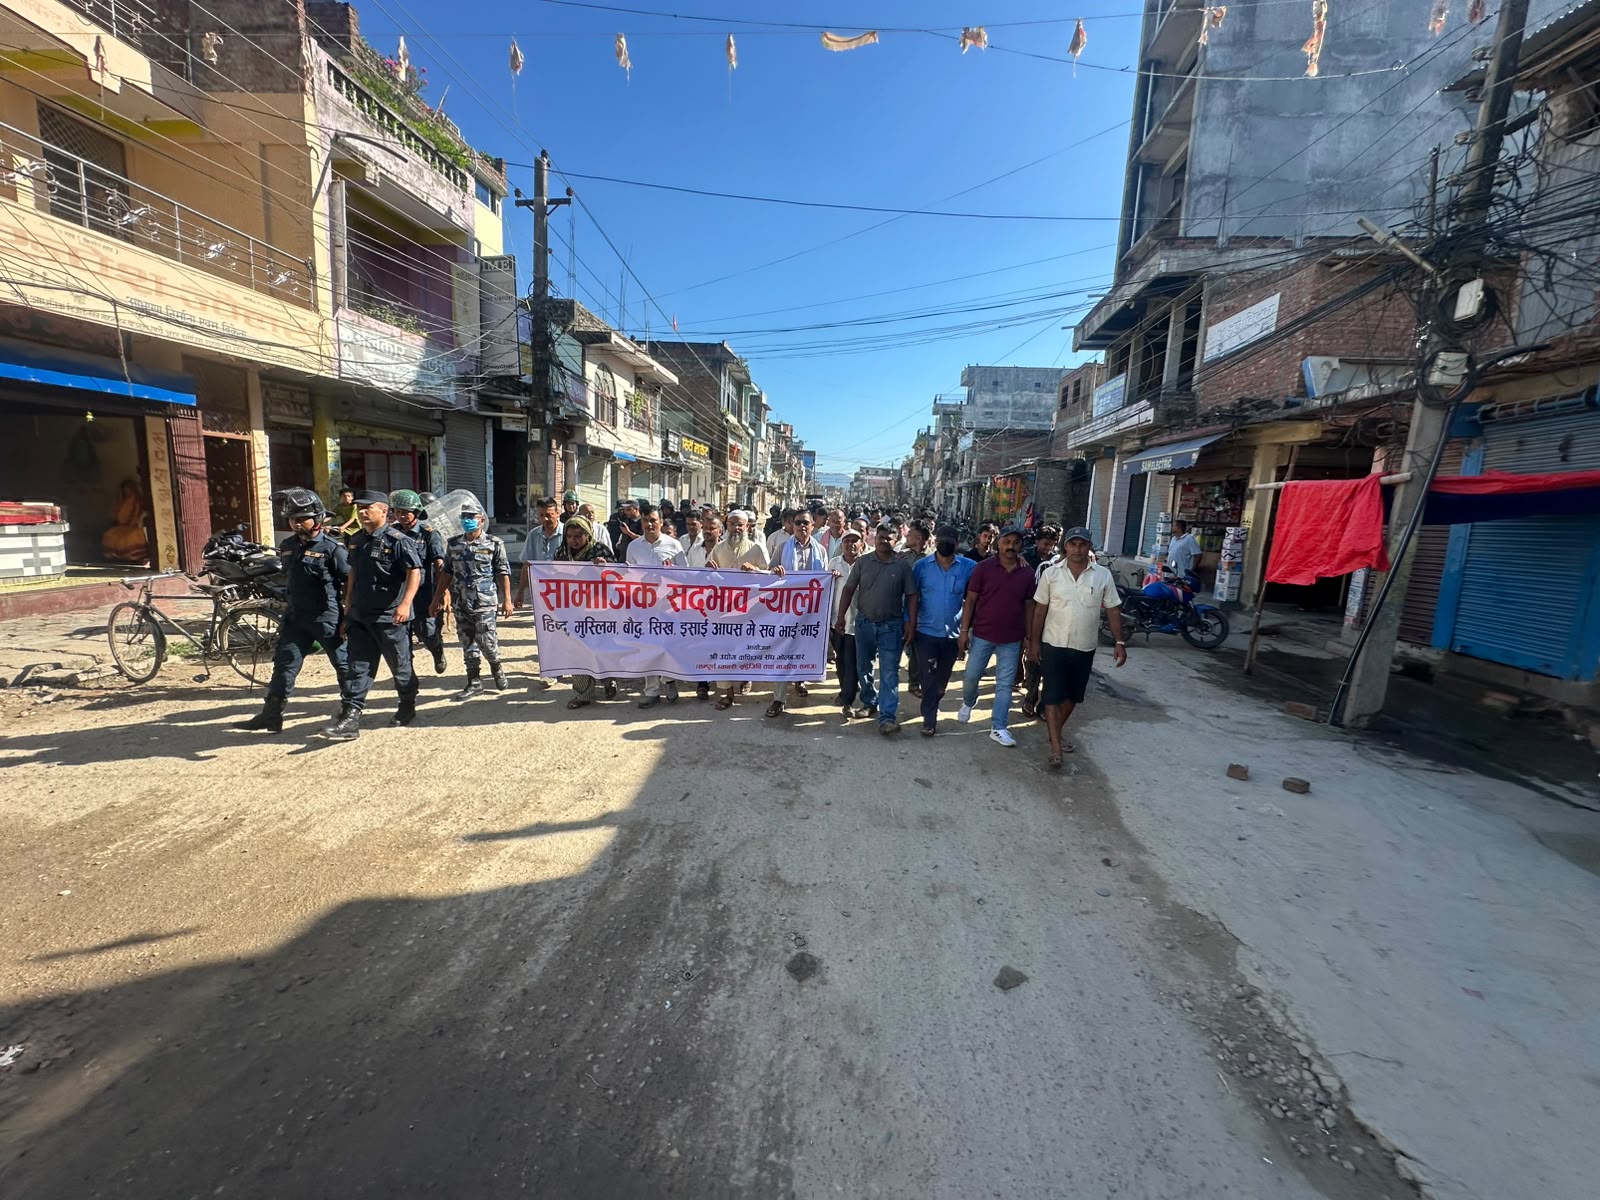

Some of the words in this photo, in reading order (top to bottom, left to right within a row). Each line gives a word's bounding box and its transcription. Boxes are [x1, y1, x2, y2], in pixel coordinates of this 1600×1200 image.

[539, 570, 658, 612] सामाजिक
[680, 618, 708, 637] इसाई
[711, 622, 743, 637] आपस
[746, 619, 756, 637] मे
[759, 623, 775, 638] सब
[779, 620, 821, 639] भाई-भाई
